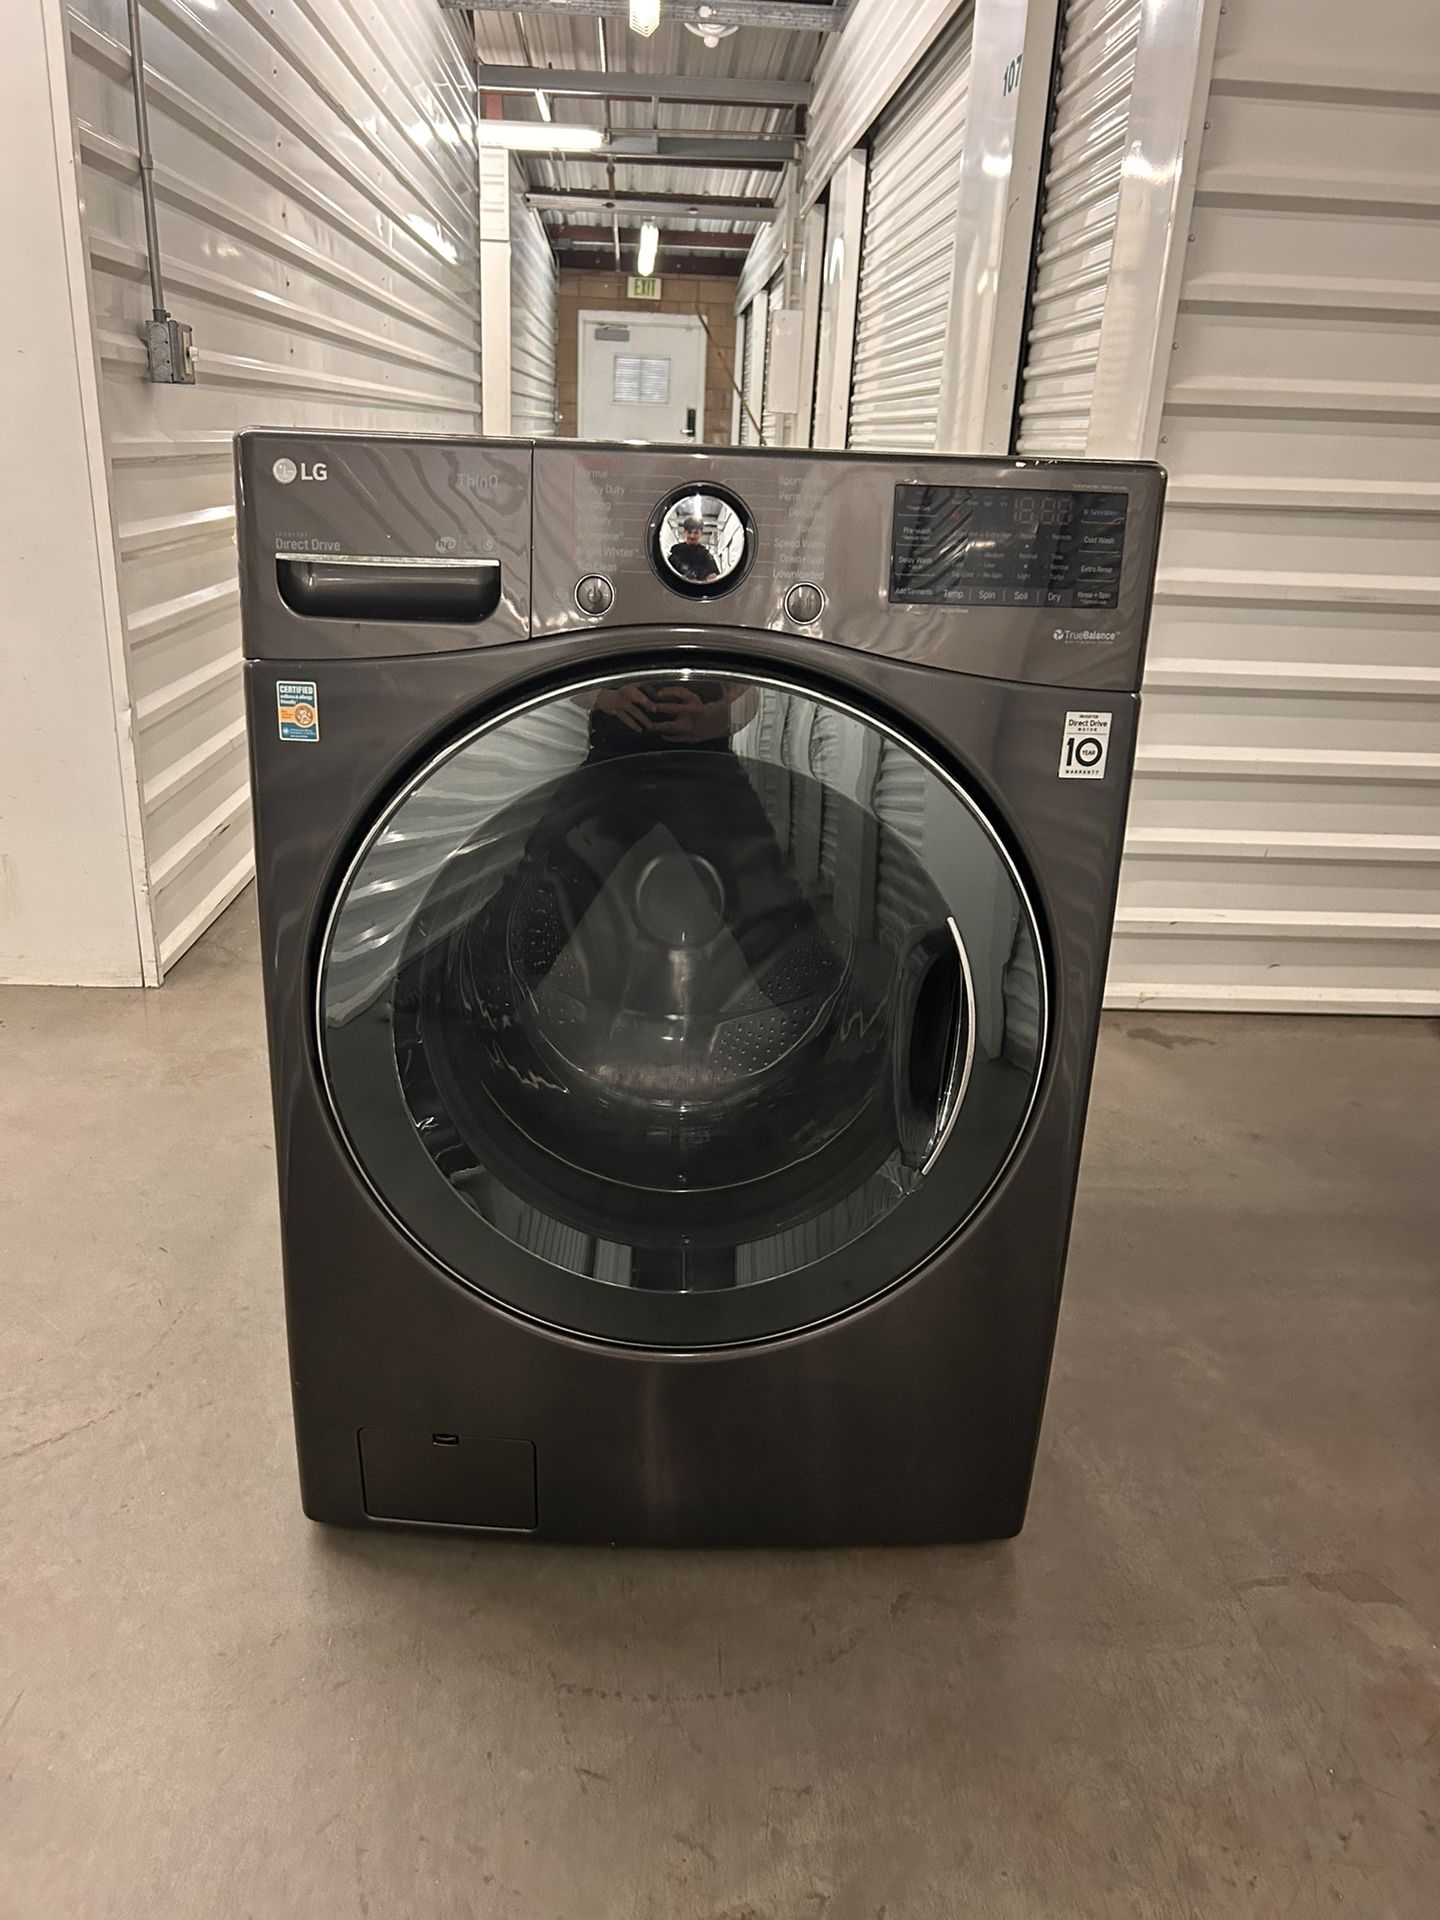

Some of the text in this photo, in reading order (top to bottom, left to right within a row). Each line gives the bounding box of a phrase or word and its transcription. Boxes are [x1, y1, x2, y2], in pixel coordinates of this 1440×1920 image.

[1003, 54, 1022, 96] 107
[634, 279, 656, 297] EXIT
[301, 463, 328, 481] LG
[605, 484, 625, 496] Duty
[275, 538, 341, 551] Direct Drive
[943, 590, 964, 600] Temp
[979, 591, 996, 600] Spin
[1014, 591, 1029, 600] Soil
[1047, 593, 1062, 603] Dry
[1068, 719, 1108, 727] Direct Drive
[1066, 737, 1103, 767] 10
